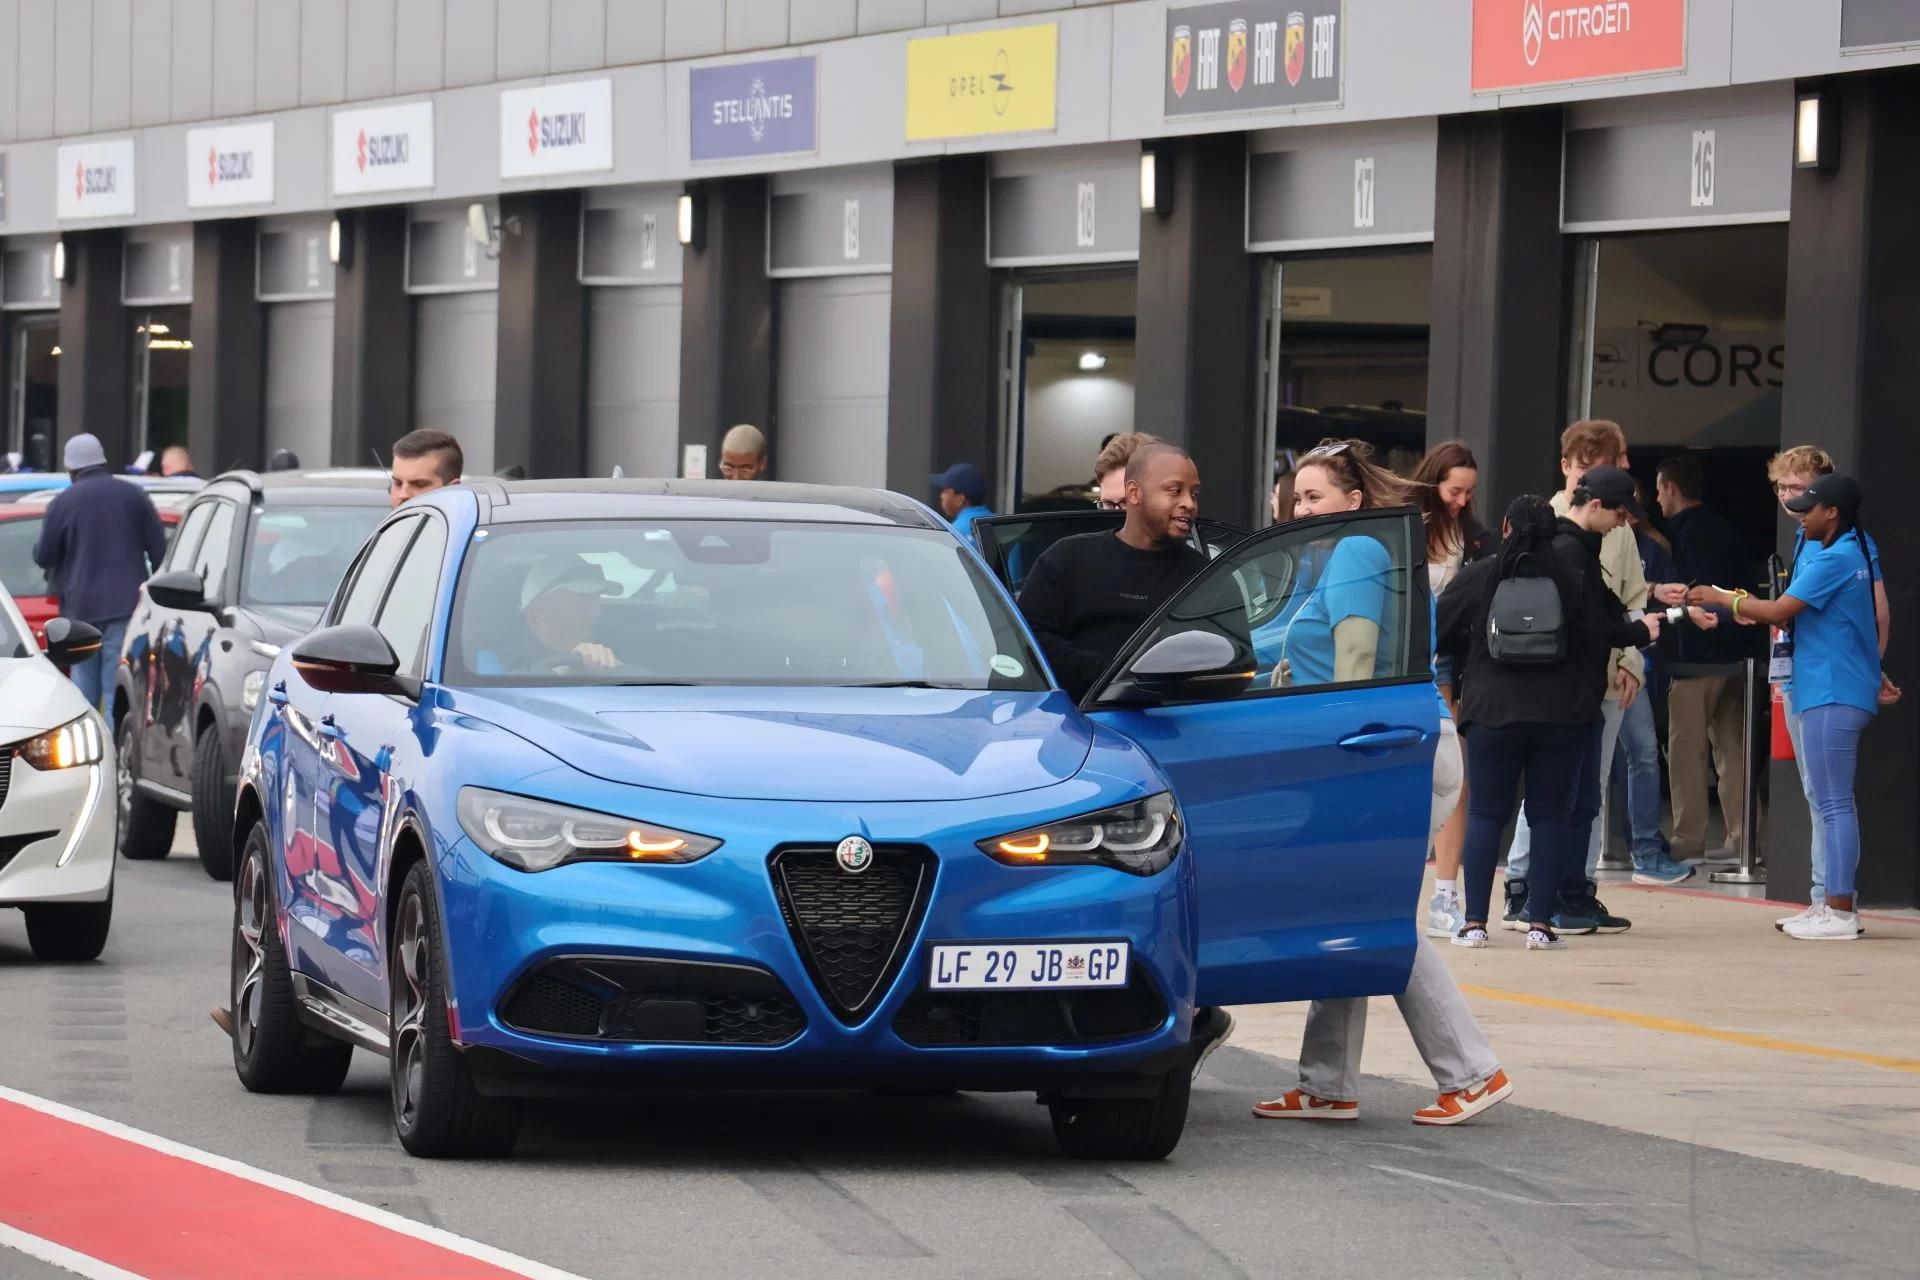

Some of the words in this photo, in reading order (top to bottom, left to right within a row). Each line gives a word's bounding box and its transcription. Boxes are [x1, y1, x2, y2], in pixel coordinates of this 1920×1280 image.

[1548, 0, 1630, 40] CITROËN
[1197, 28, 1221, 90] FIAT
[1254, 22, 1278, 85] FIAT
[1312, 15, 1336, 78] FIAT
[950, 75, 985, 97] OPEL
[713, 94, 793, 125] STELLANTIS
[541, 112, 586, 147] SUZUKI
[218, 150, 253, 181] SUZUKI
[368, 133, 409, 166] SUZUKI
[85, 166, 117, 194] SUZUKI
[1694, 141, 1713, 198] 16
[1358, 169, 1372, 219] 17
[1080, 193, 1093, 239] 18
[938, 951, 972, 984] LF
[984, 950, 1018, 983] 29
[1031, 949, 1063, 983] JB
[1088, 948, 1120, 981] GP
